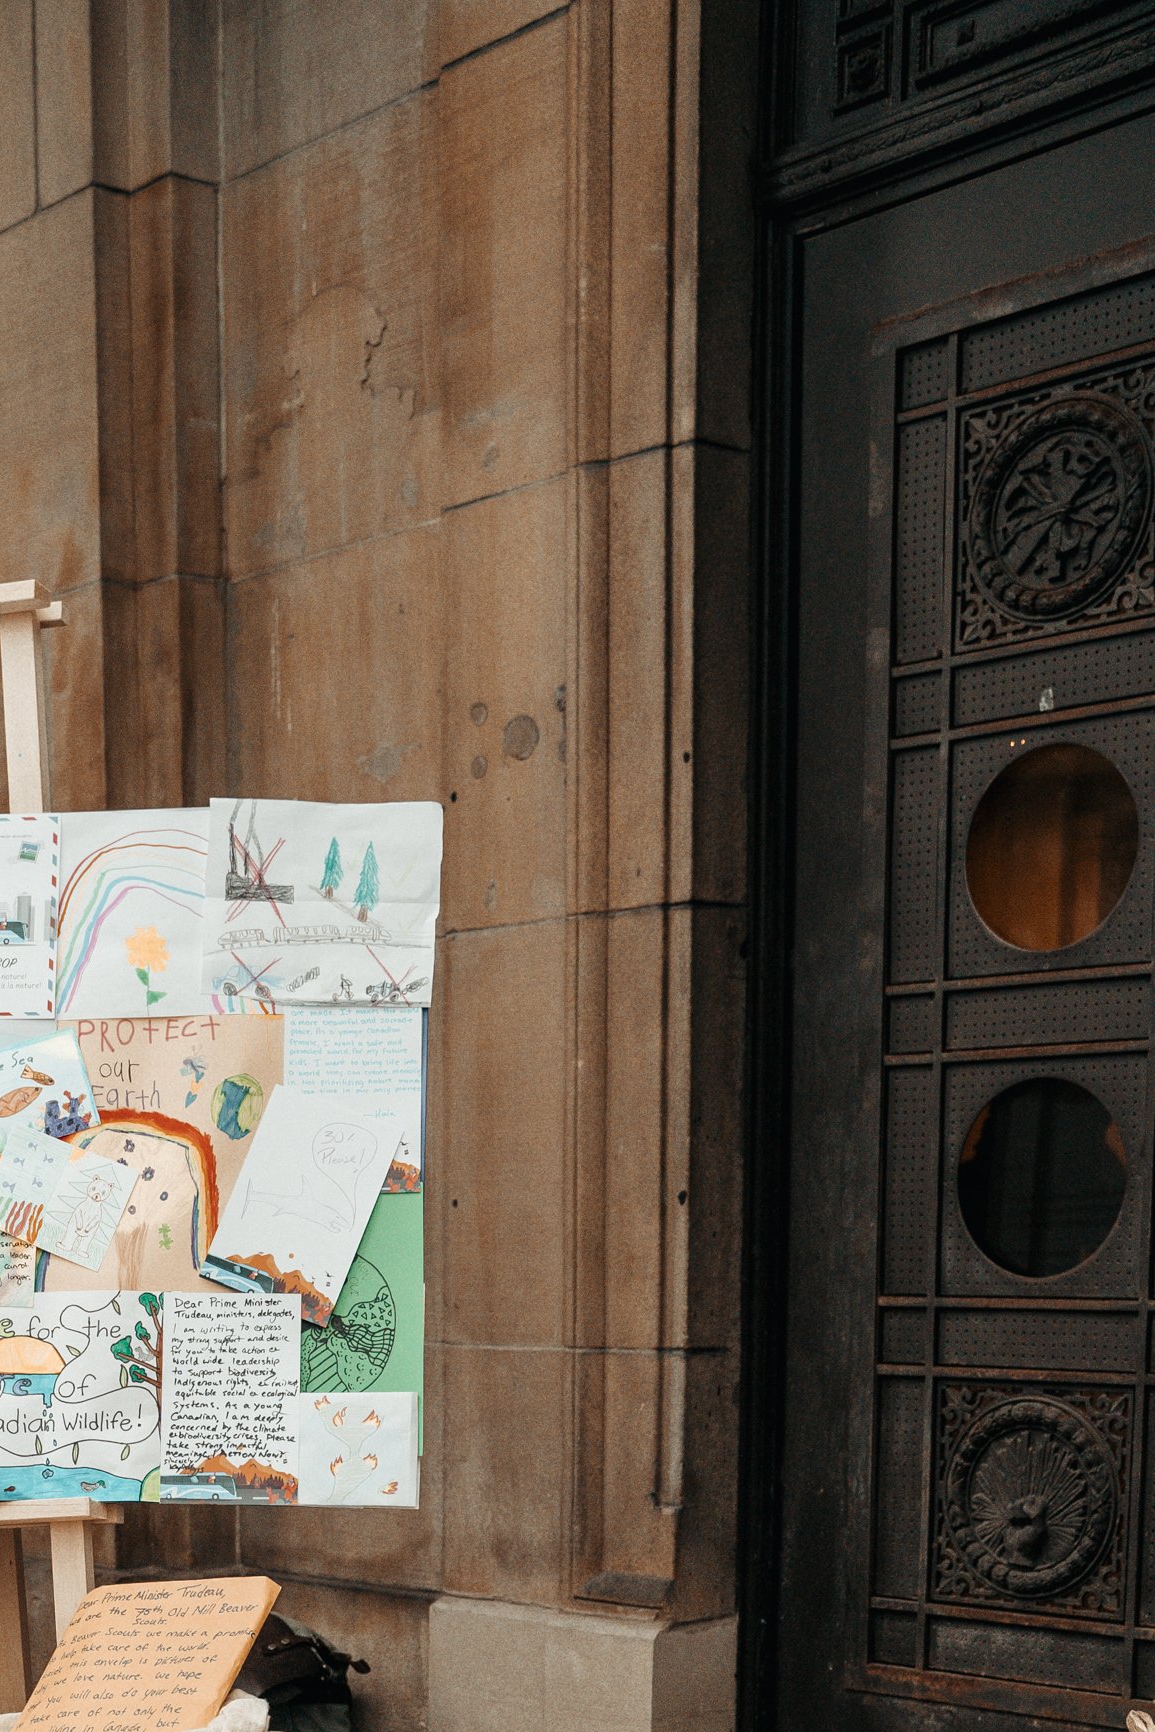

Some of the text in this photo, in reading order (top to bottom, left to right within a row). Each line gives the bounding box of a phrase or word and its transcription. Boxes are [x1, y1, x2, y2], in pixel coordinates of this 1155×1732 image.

[11, 1051, 34, 1066] Sea
[99, 1060, 140, 1082] our
[92, 1081, 160, 1110] Earth
[175, 1295, 282, 1309] Dear Prime Minister
[174, 1310, 214, 1321] Trudeau,
[27, 1315, 60, 1340] for
[82, 1317, 122, 1338] the
[58, 1373, 96, 1397] of
[62, 1403, 142, 1432] Wildlife!
[102, 1592, 131, 1604] Prime
[135, 1589, 174, 1600] Minister
[177, 1584, 226, 1598] Trudeau,
[109, 1606, 127, 1616] the
[168, 1608, 187, 1617] Old
[193, 1604, 217, 1616] Mill
[218, 1602, 258, 1614] Beaver
